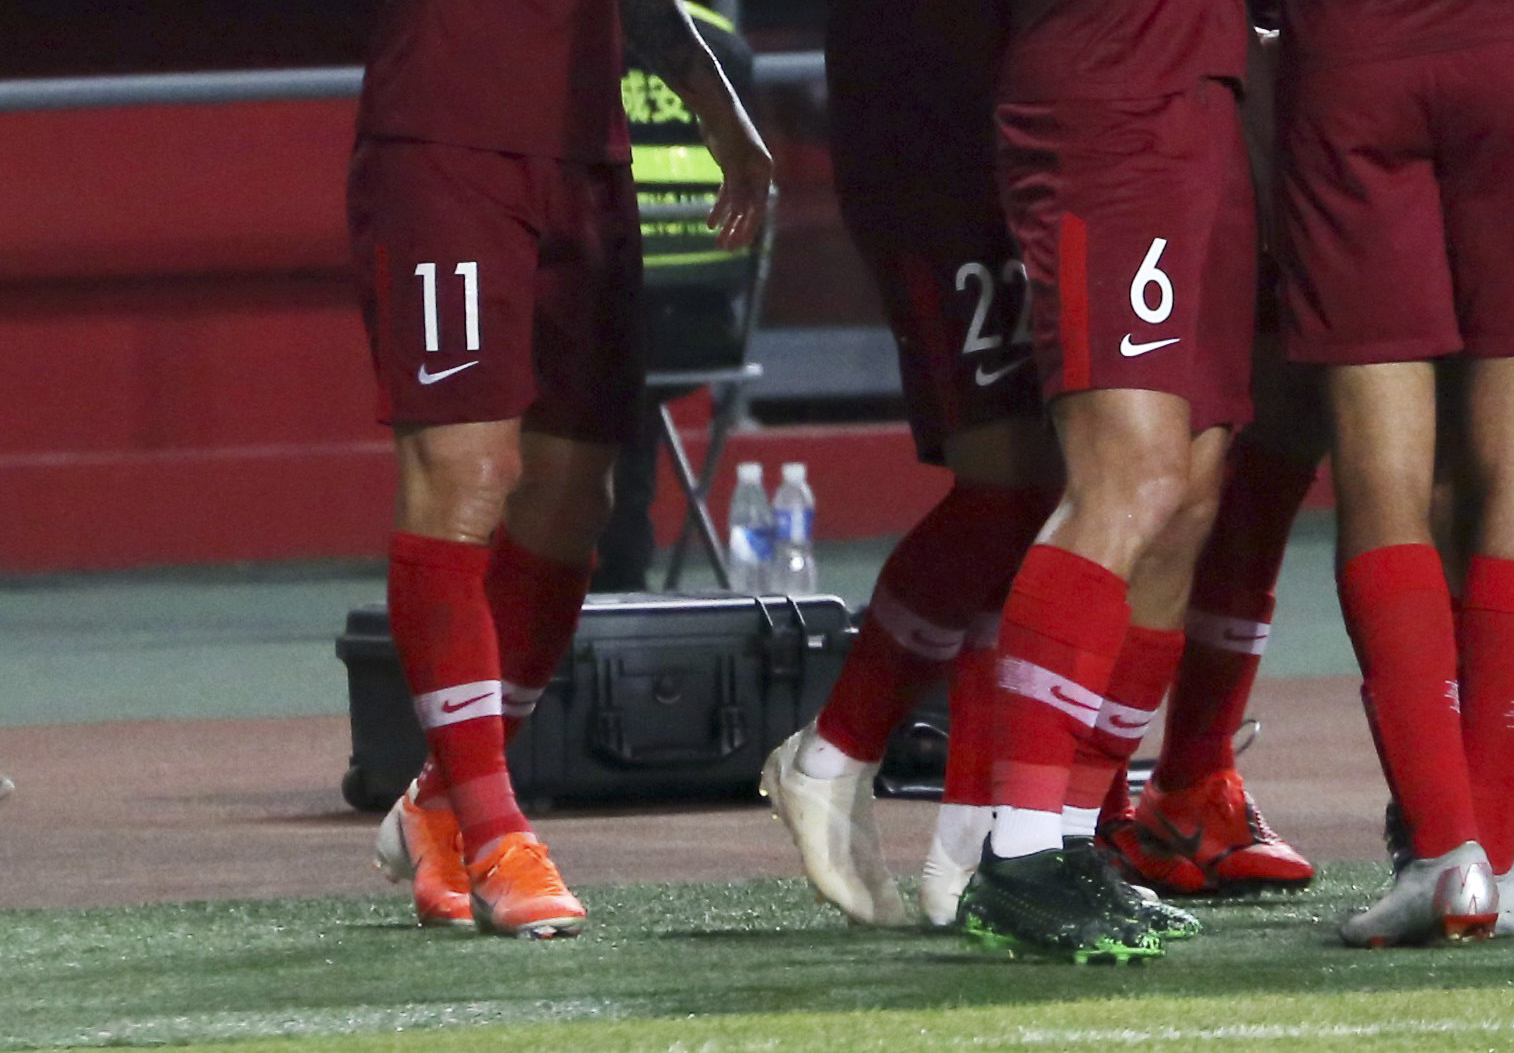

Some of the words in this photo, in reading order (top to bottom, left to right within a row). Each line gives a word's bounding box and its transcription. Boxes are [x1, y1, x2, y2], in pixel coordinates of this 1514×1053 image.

[414, 261, 480, 352] 11
[955, 261, 1032, 355] 22
[1130, 237, 1175, 324] 6
